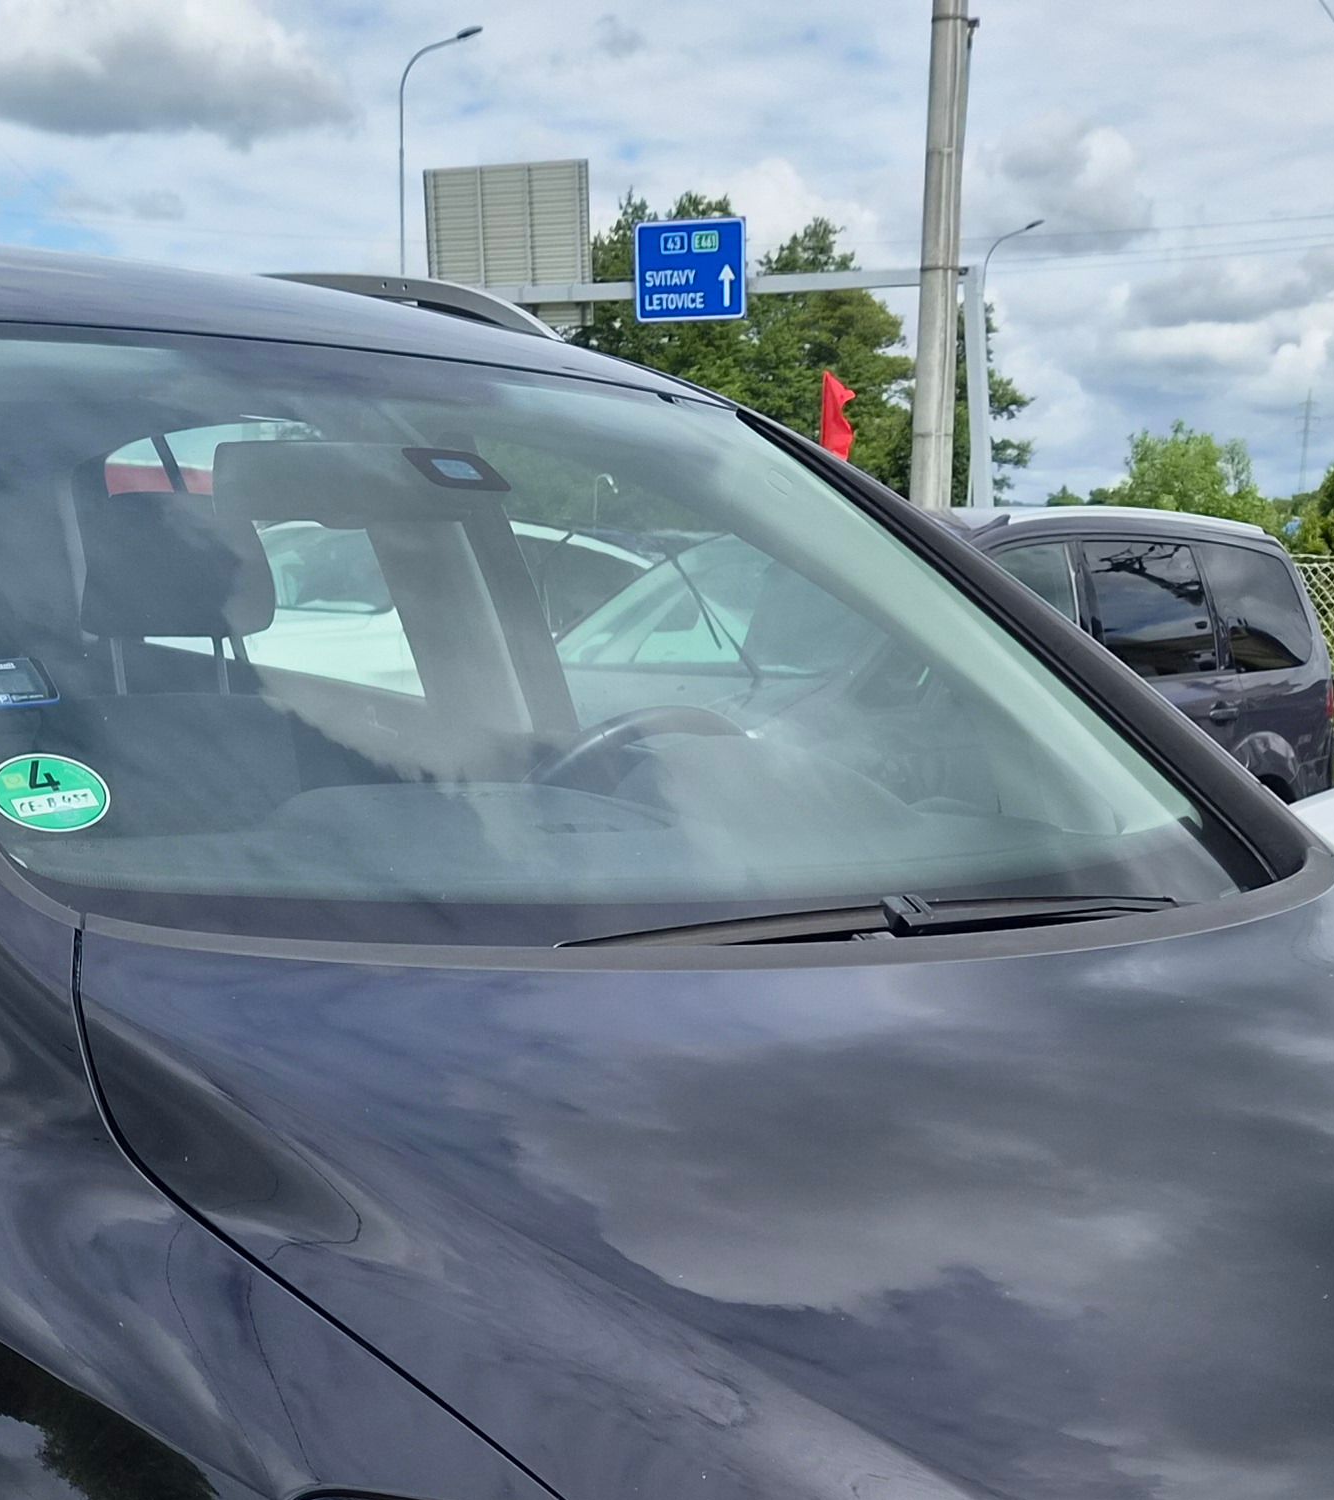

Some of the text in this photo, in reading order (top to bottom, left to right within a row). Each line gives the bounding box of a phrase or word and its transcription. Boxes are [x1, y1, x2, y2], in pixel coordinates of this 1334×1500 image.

[666, 236, 681, 250] 43
[694, 234, 716, 249] E461
[645, 269, 696, 287] SVITAVY
[645, 292, 704, 311] LETOVICE
[28, 760, 60, 790] 4
